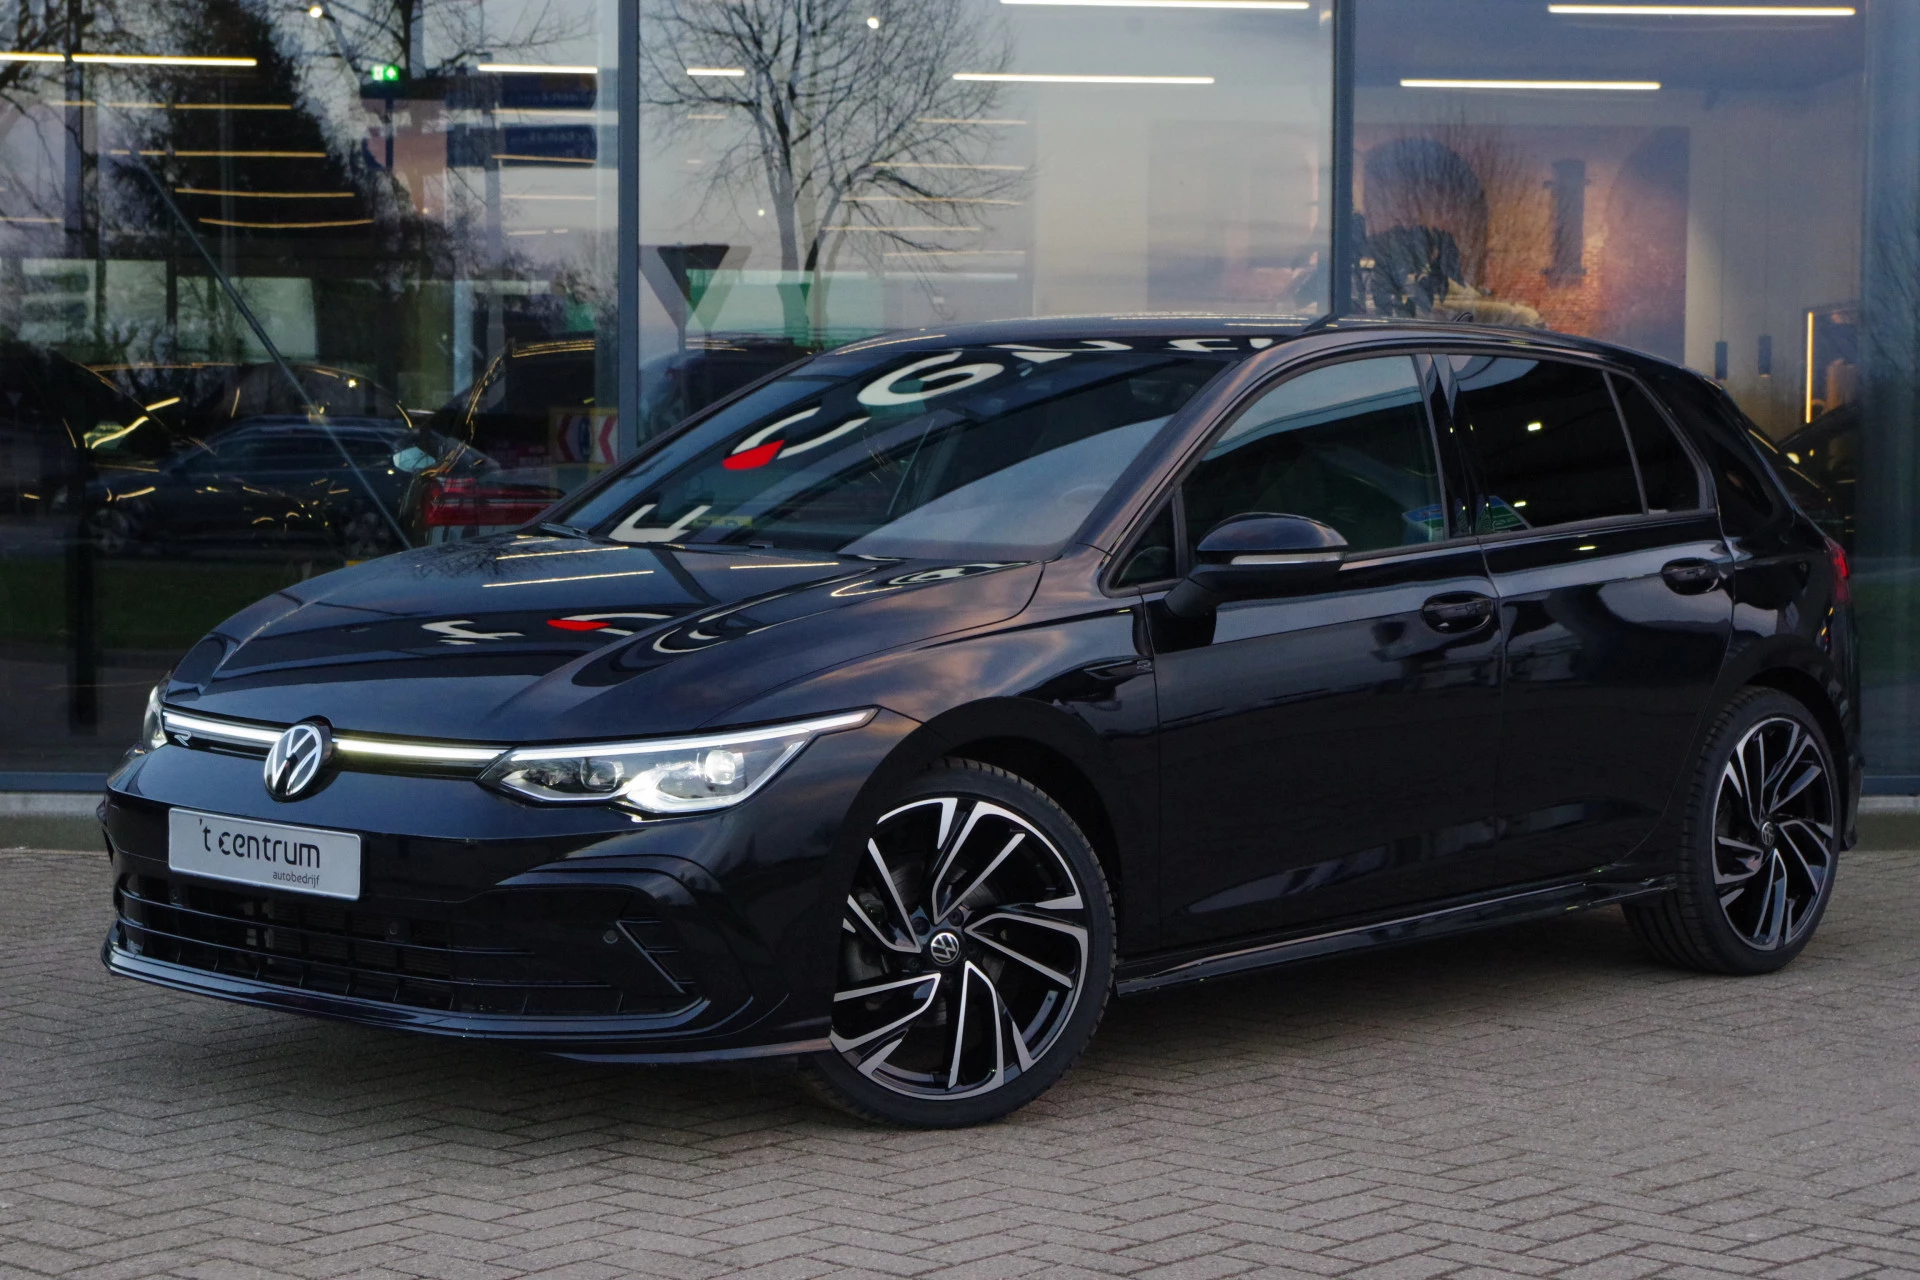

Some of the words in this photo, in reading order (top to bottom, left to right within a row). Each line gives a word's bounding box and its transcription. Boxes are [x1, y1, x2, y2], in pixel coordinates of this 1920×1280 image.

[174, 730, 192, 747] R
[218, 831, 320, 868] centrum
[272, 870, 320, 888] autobedrijf
